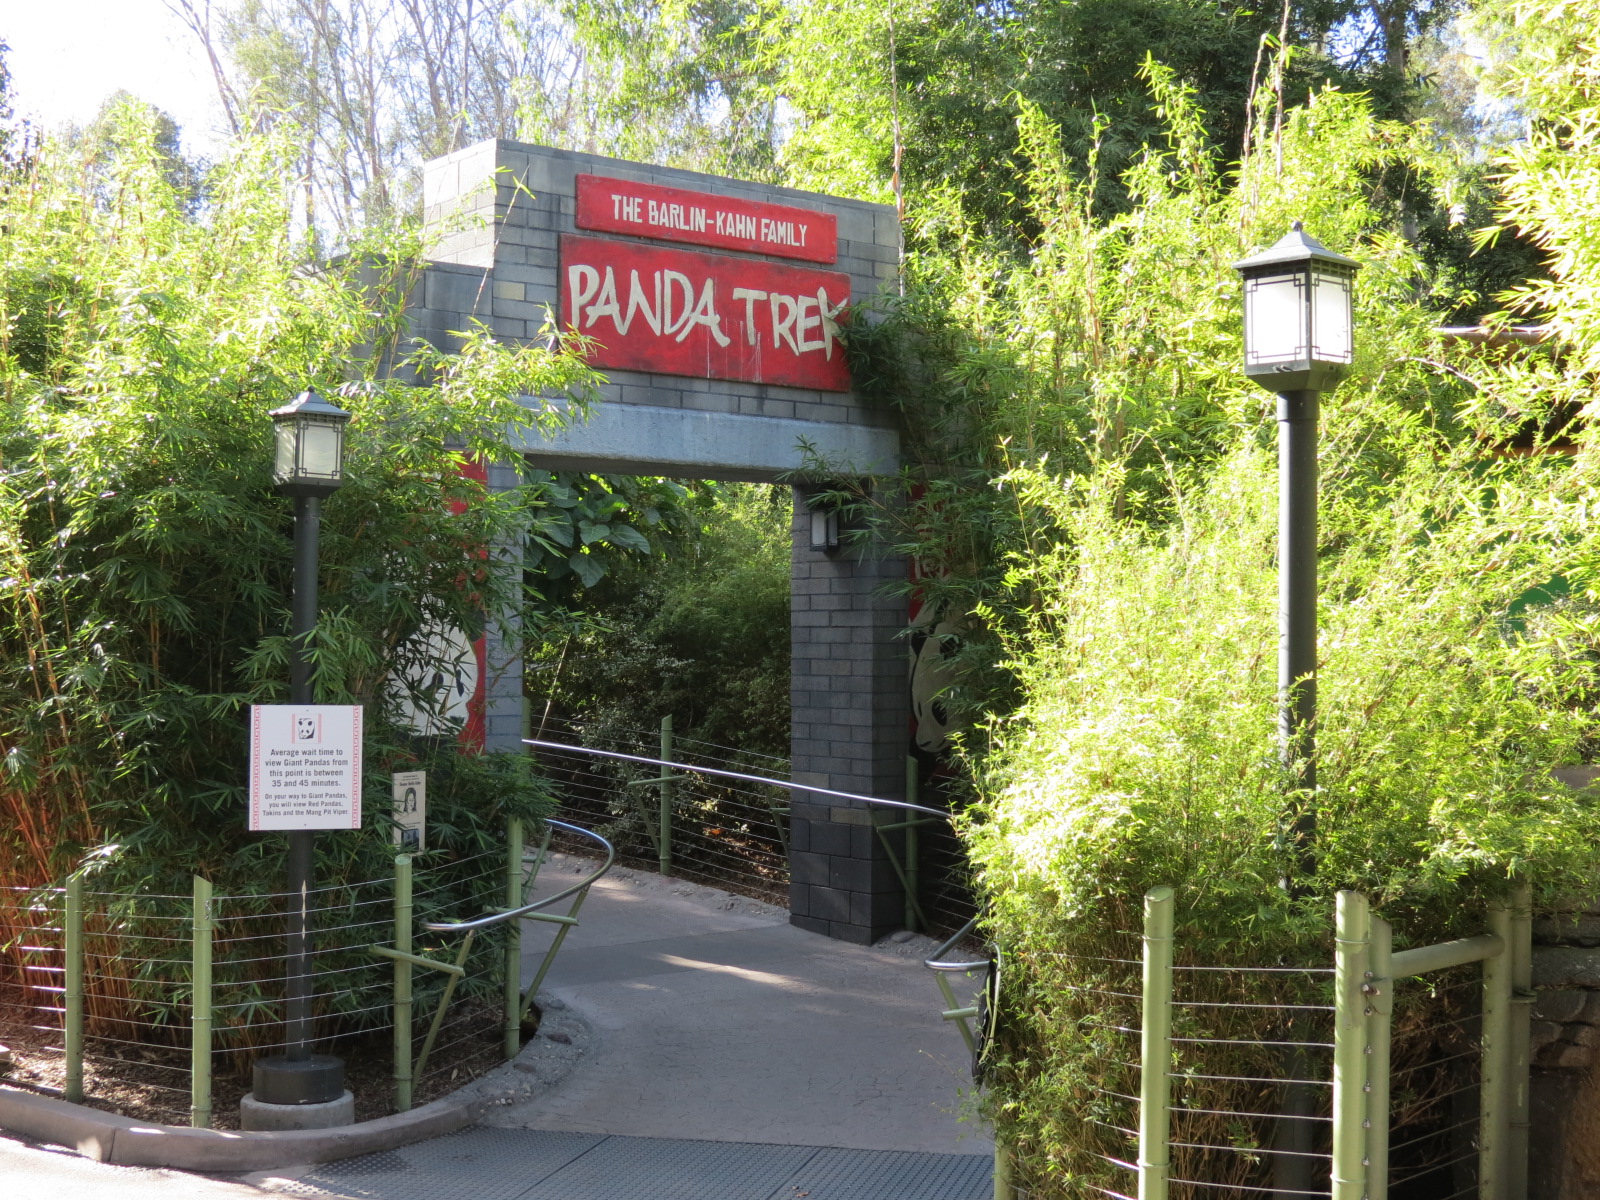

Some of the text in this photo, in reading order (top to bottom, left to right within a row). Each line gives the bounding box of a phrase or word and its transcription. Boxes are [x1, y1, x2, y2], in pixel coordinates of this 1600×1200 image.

[612, 195, 807, 246] THE BARLIN-KAHN FAMILY
[569, 265, 848, 361] PANDA TREK
